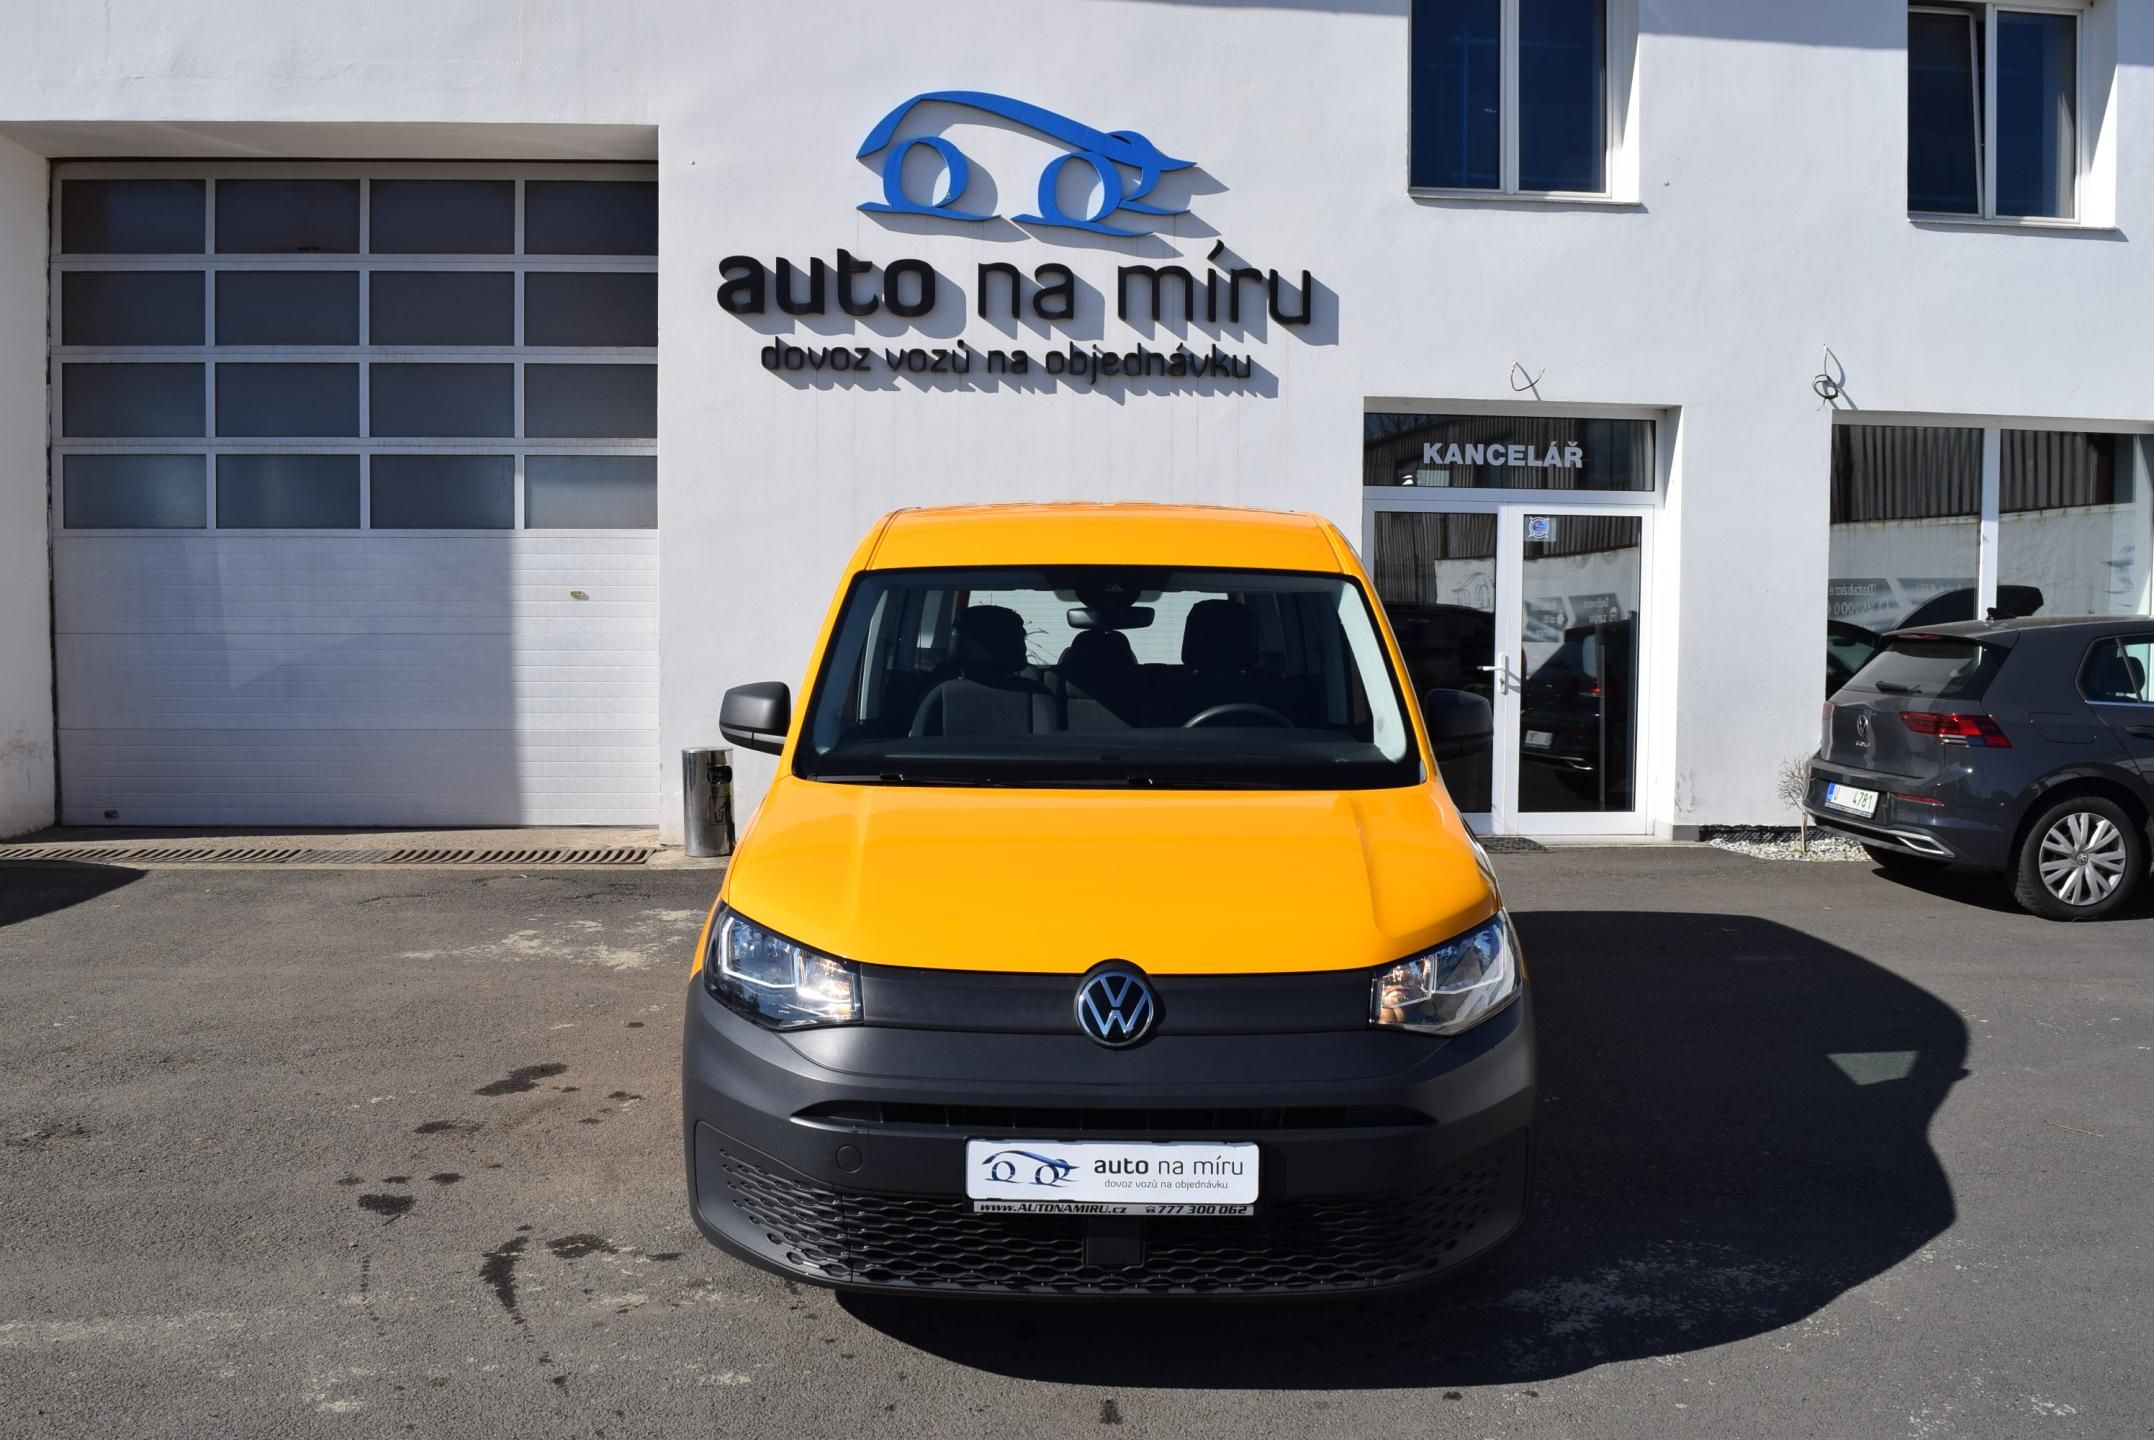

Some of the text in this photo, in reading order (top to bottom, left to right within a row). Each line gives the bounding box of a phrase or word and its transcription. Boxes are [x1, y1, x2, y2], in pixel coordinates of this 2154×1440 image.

[716, 239, 1312, 325] auto na míru
[760, 336, 1252, 385] dovoz vozů na objednávku
[1423, 441, 1583, 468] KANCELÁŘ
[1094, 1155, 1243, 1176] auto na míru
[1104, 1179, 1228, 1191] dovoz vozů na objednávku
[980, 1203, 1247, 1214] www.AUTONAMIRU.cz 777 300 062
